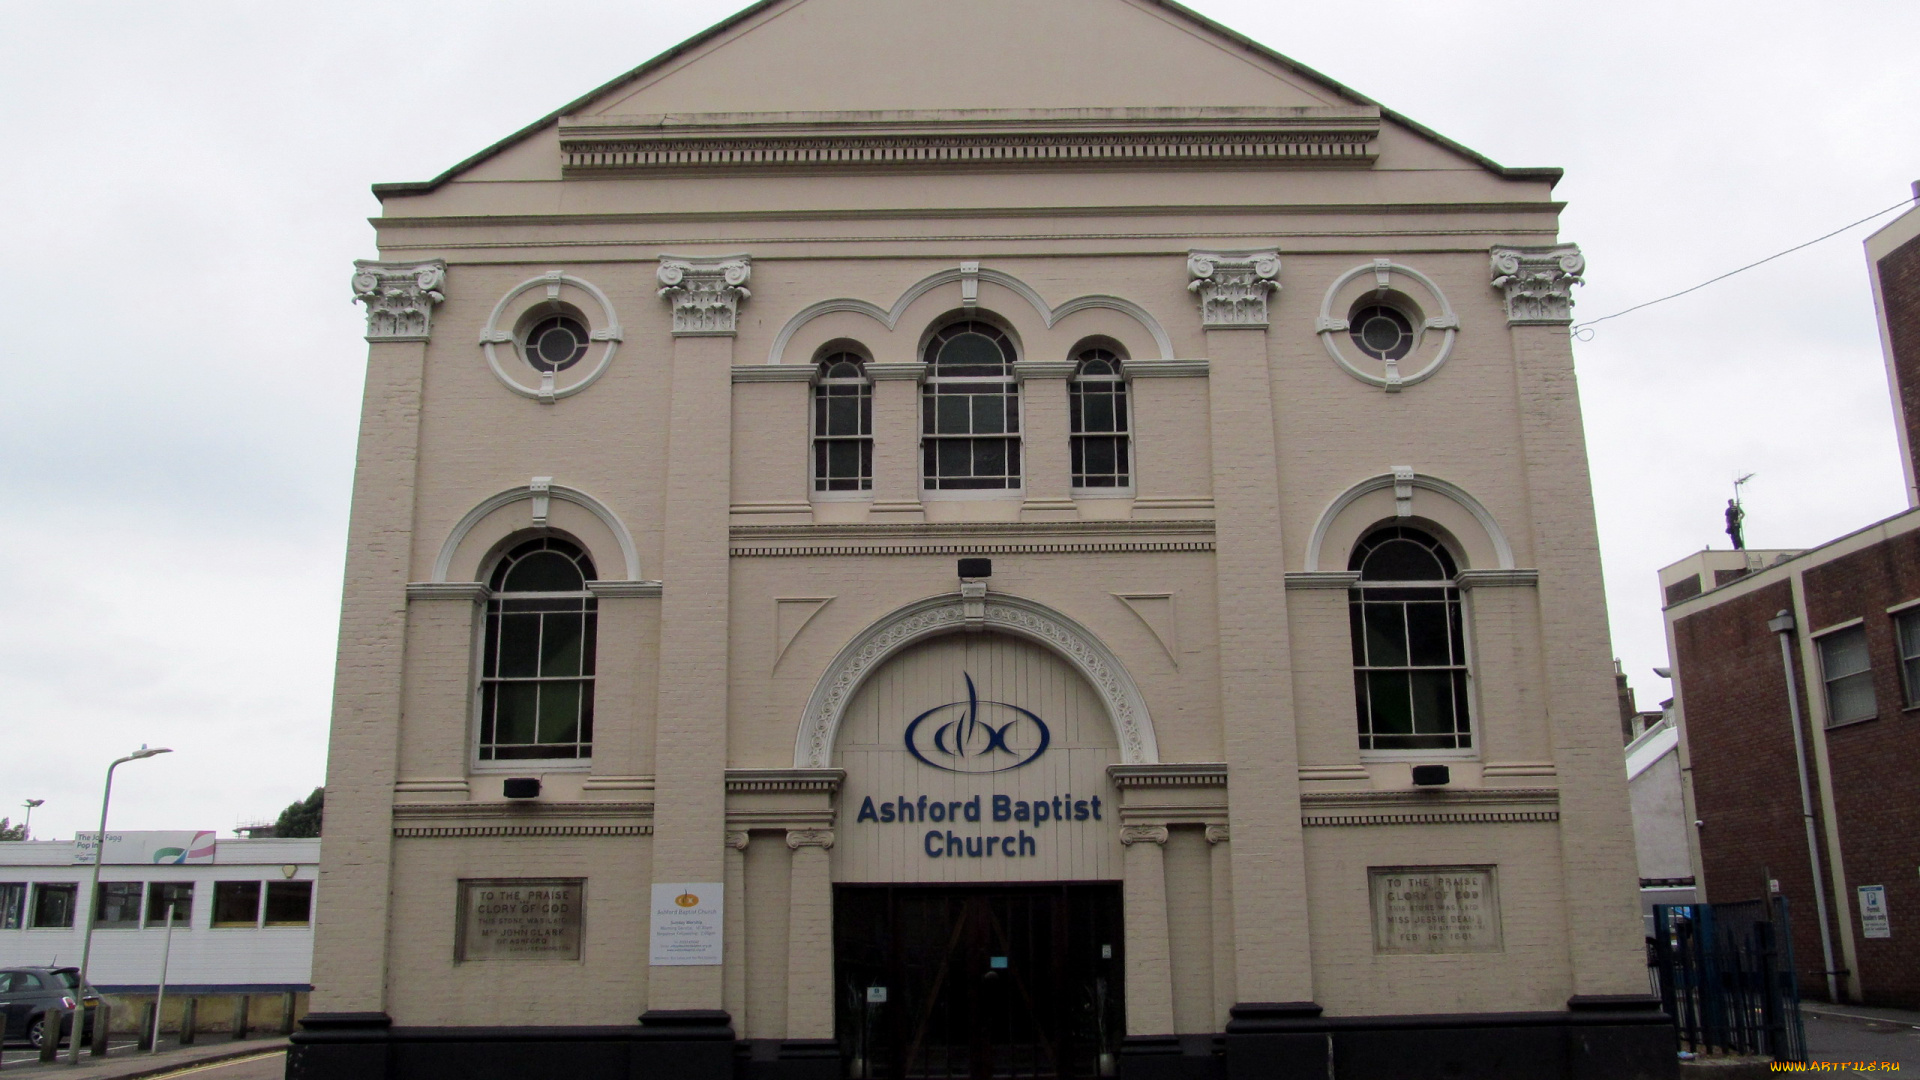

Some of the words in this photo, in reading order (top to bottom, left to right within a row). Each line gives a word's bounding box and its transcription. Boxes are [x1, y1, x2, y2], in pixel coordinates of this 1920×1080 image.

[857, 794, 980, 823] Ashford
[992, 794, 1102, 827] Baptist
[105, 834, 122, 843] Fagg
[924, 829, 1036, 858] Church
[77, 841, 91, 850] Pop
[1386, 878, 1402, 888] TO
[1408, 878, 1430, 887] THE
[1438, 877, 1479, 887] PRAISE
[480, 891, 494, 900] TO
[500, 891, 521, 900] THE
[528, 890, 570, 900] PRAISE
[1387, 891, 1427, 901] GLORY
[1434, 891, 1449, 900] OF
[1455, 890, 1479, 900] GOD
[478, 904, 517, 914] GLORY
[521, 904, 536, 914] OF
[542, 903, 570, 914] GOD
[500, 929, 528, 937] JOHN
[530, 928, 565, 936] CLARK
